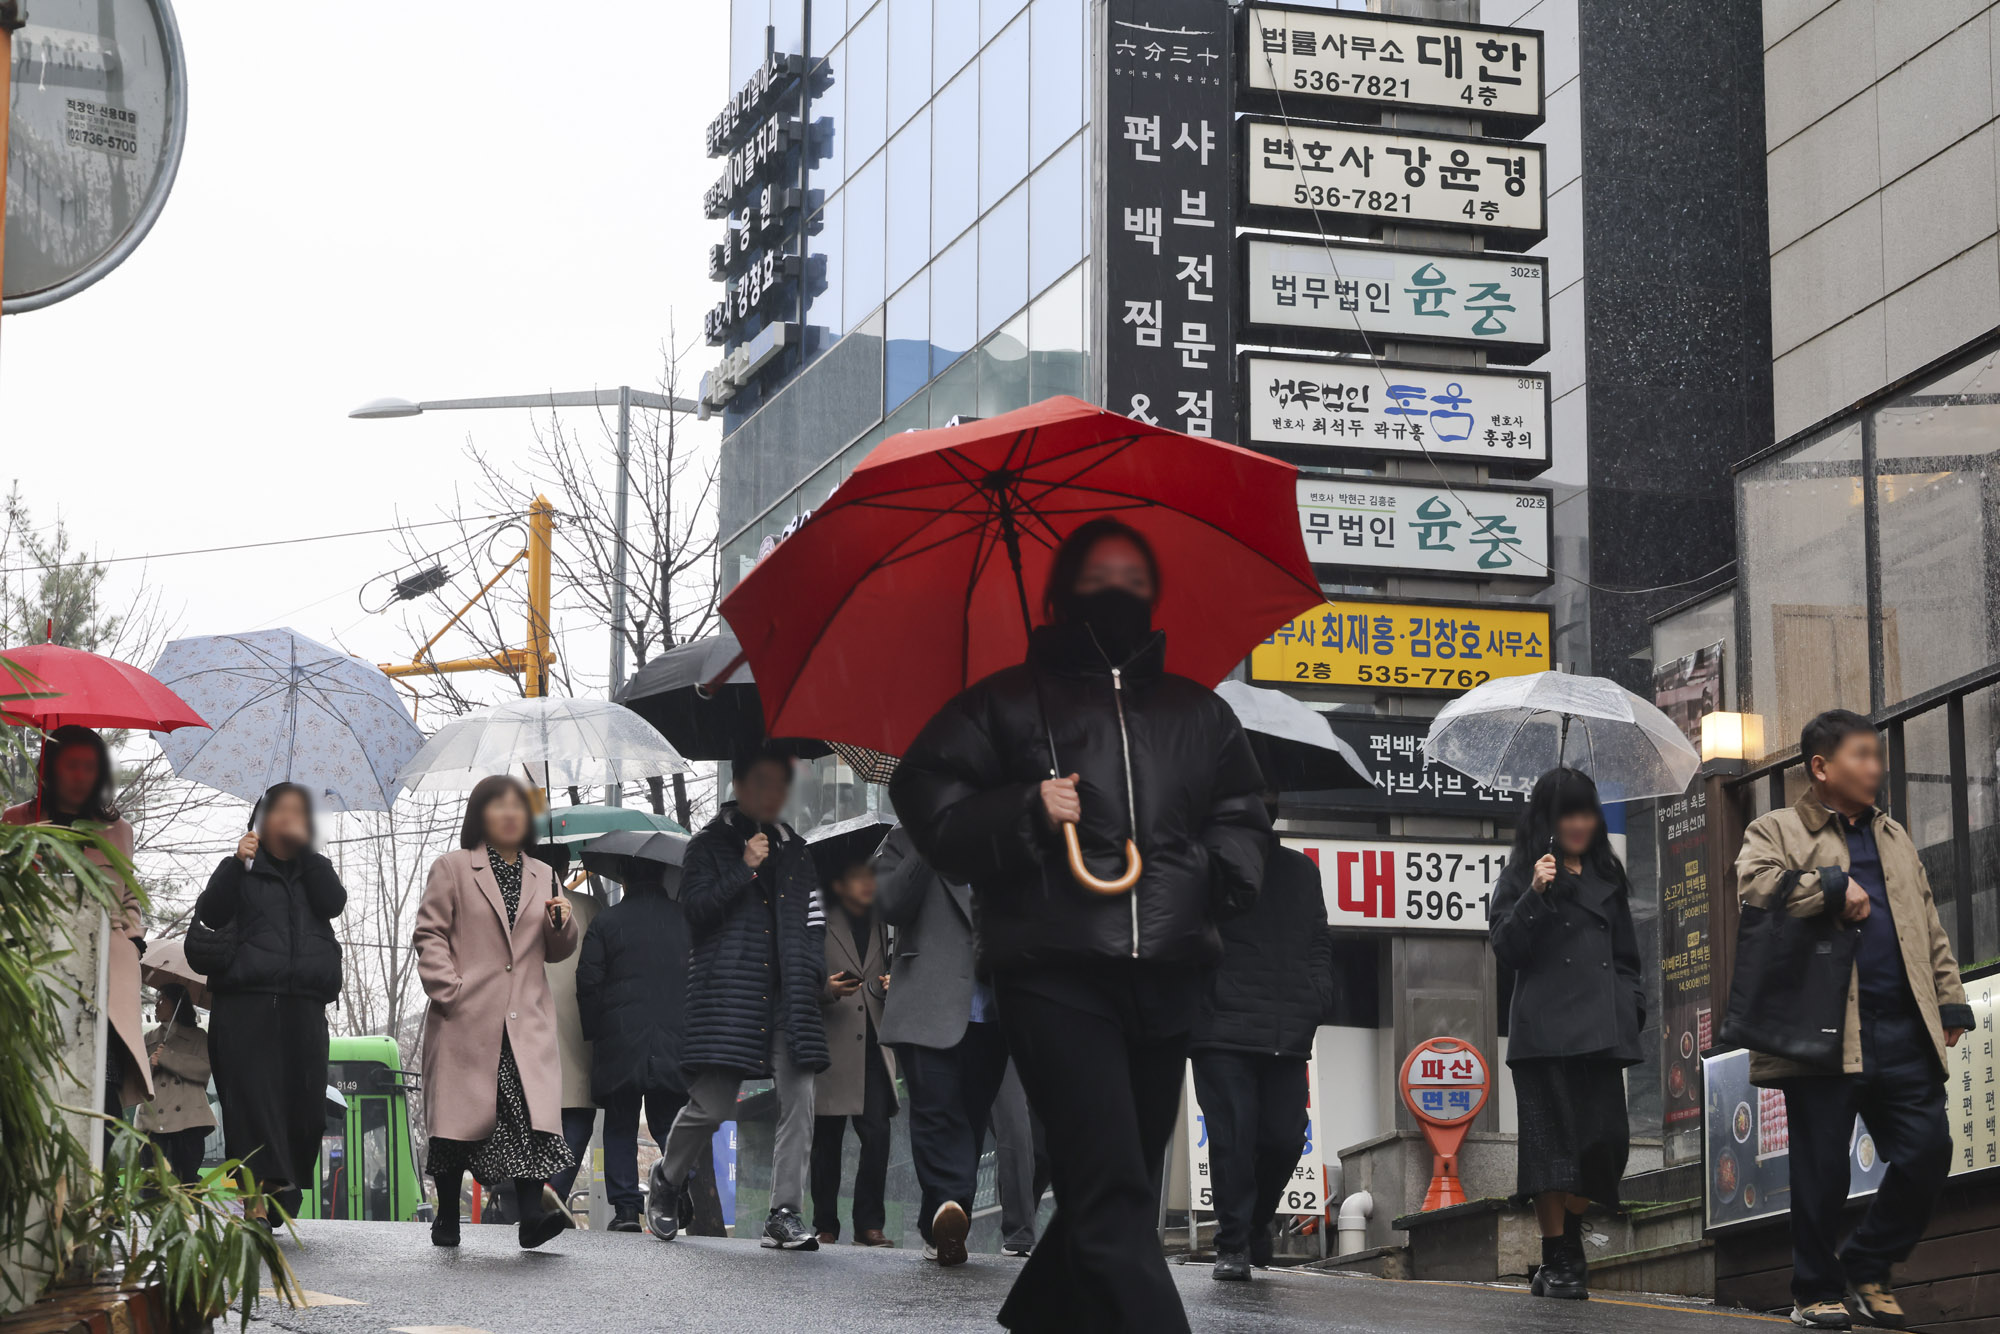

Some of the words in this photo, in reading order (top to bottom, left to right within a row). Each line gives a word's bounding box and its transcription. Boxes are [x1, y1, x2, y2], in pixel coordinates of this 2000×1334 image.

[1115, 39, 1219, 66] 六分三十
[1262, 27, 1404, 64] 법률사무소
[1416, 34, 1527, 86] 대한
[1293, 69, 1411, 99] 536-7821
[1460, 84, 1498, 107] 4층
[1263, 137, 1374, 178] 변호사
[1385, 146, 1527, 197] 강윤경
[1294, 184, 1411, 213] 536-7821
[1461, 199, 1499, 221] 4층
[1172, 119, 1216, 438] 샤브전문점
[1510, 266, 1541, 279] 302호
[1271, 274, 1391, 314] 법무법인
[1403, 262, 1517, 336] 윤중
[704, 291, 733, 346] 변호사
[1269, 379, 1370, 413] 법무법인
[1517, 379, 1543, 391] 301호
[1271, 417, 1305, 431] 변호사
[1312, 417, 1364, 437] 최석두
[1373, 422, 1425, 442] 곽규홍
[1491, 415, 1524, 428] 변호사
[1482, 430, 1532, 450] 홍광의
[1310, 492, 1334, 503] 변호사
[1515, 497, 1546, 509] 202호
[1407, 495, 1523, 570] 윤중
[1260, 620, 1316, 647] 무사
[1486, 629, 1543, 658] 사무소
[1295, 661, 1332, 680] 2층
[1358, 664, 1491, 688] 535-7762
[1374, 769, 1467, 798] 샤브샤브
[1664, 881, 1684, 902] 소고기
[1421, 1059, 1474, 1080] 파산
[337, 1080, 358, 1091] 9149
[1422, 1091, 1470, 1112] 면책
[1291, 1166, 1316, 1180] 무소
